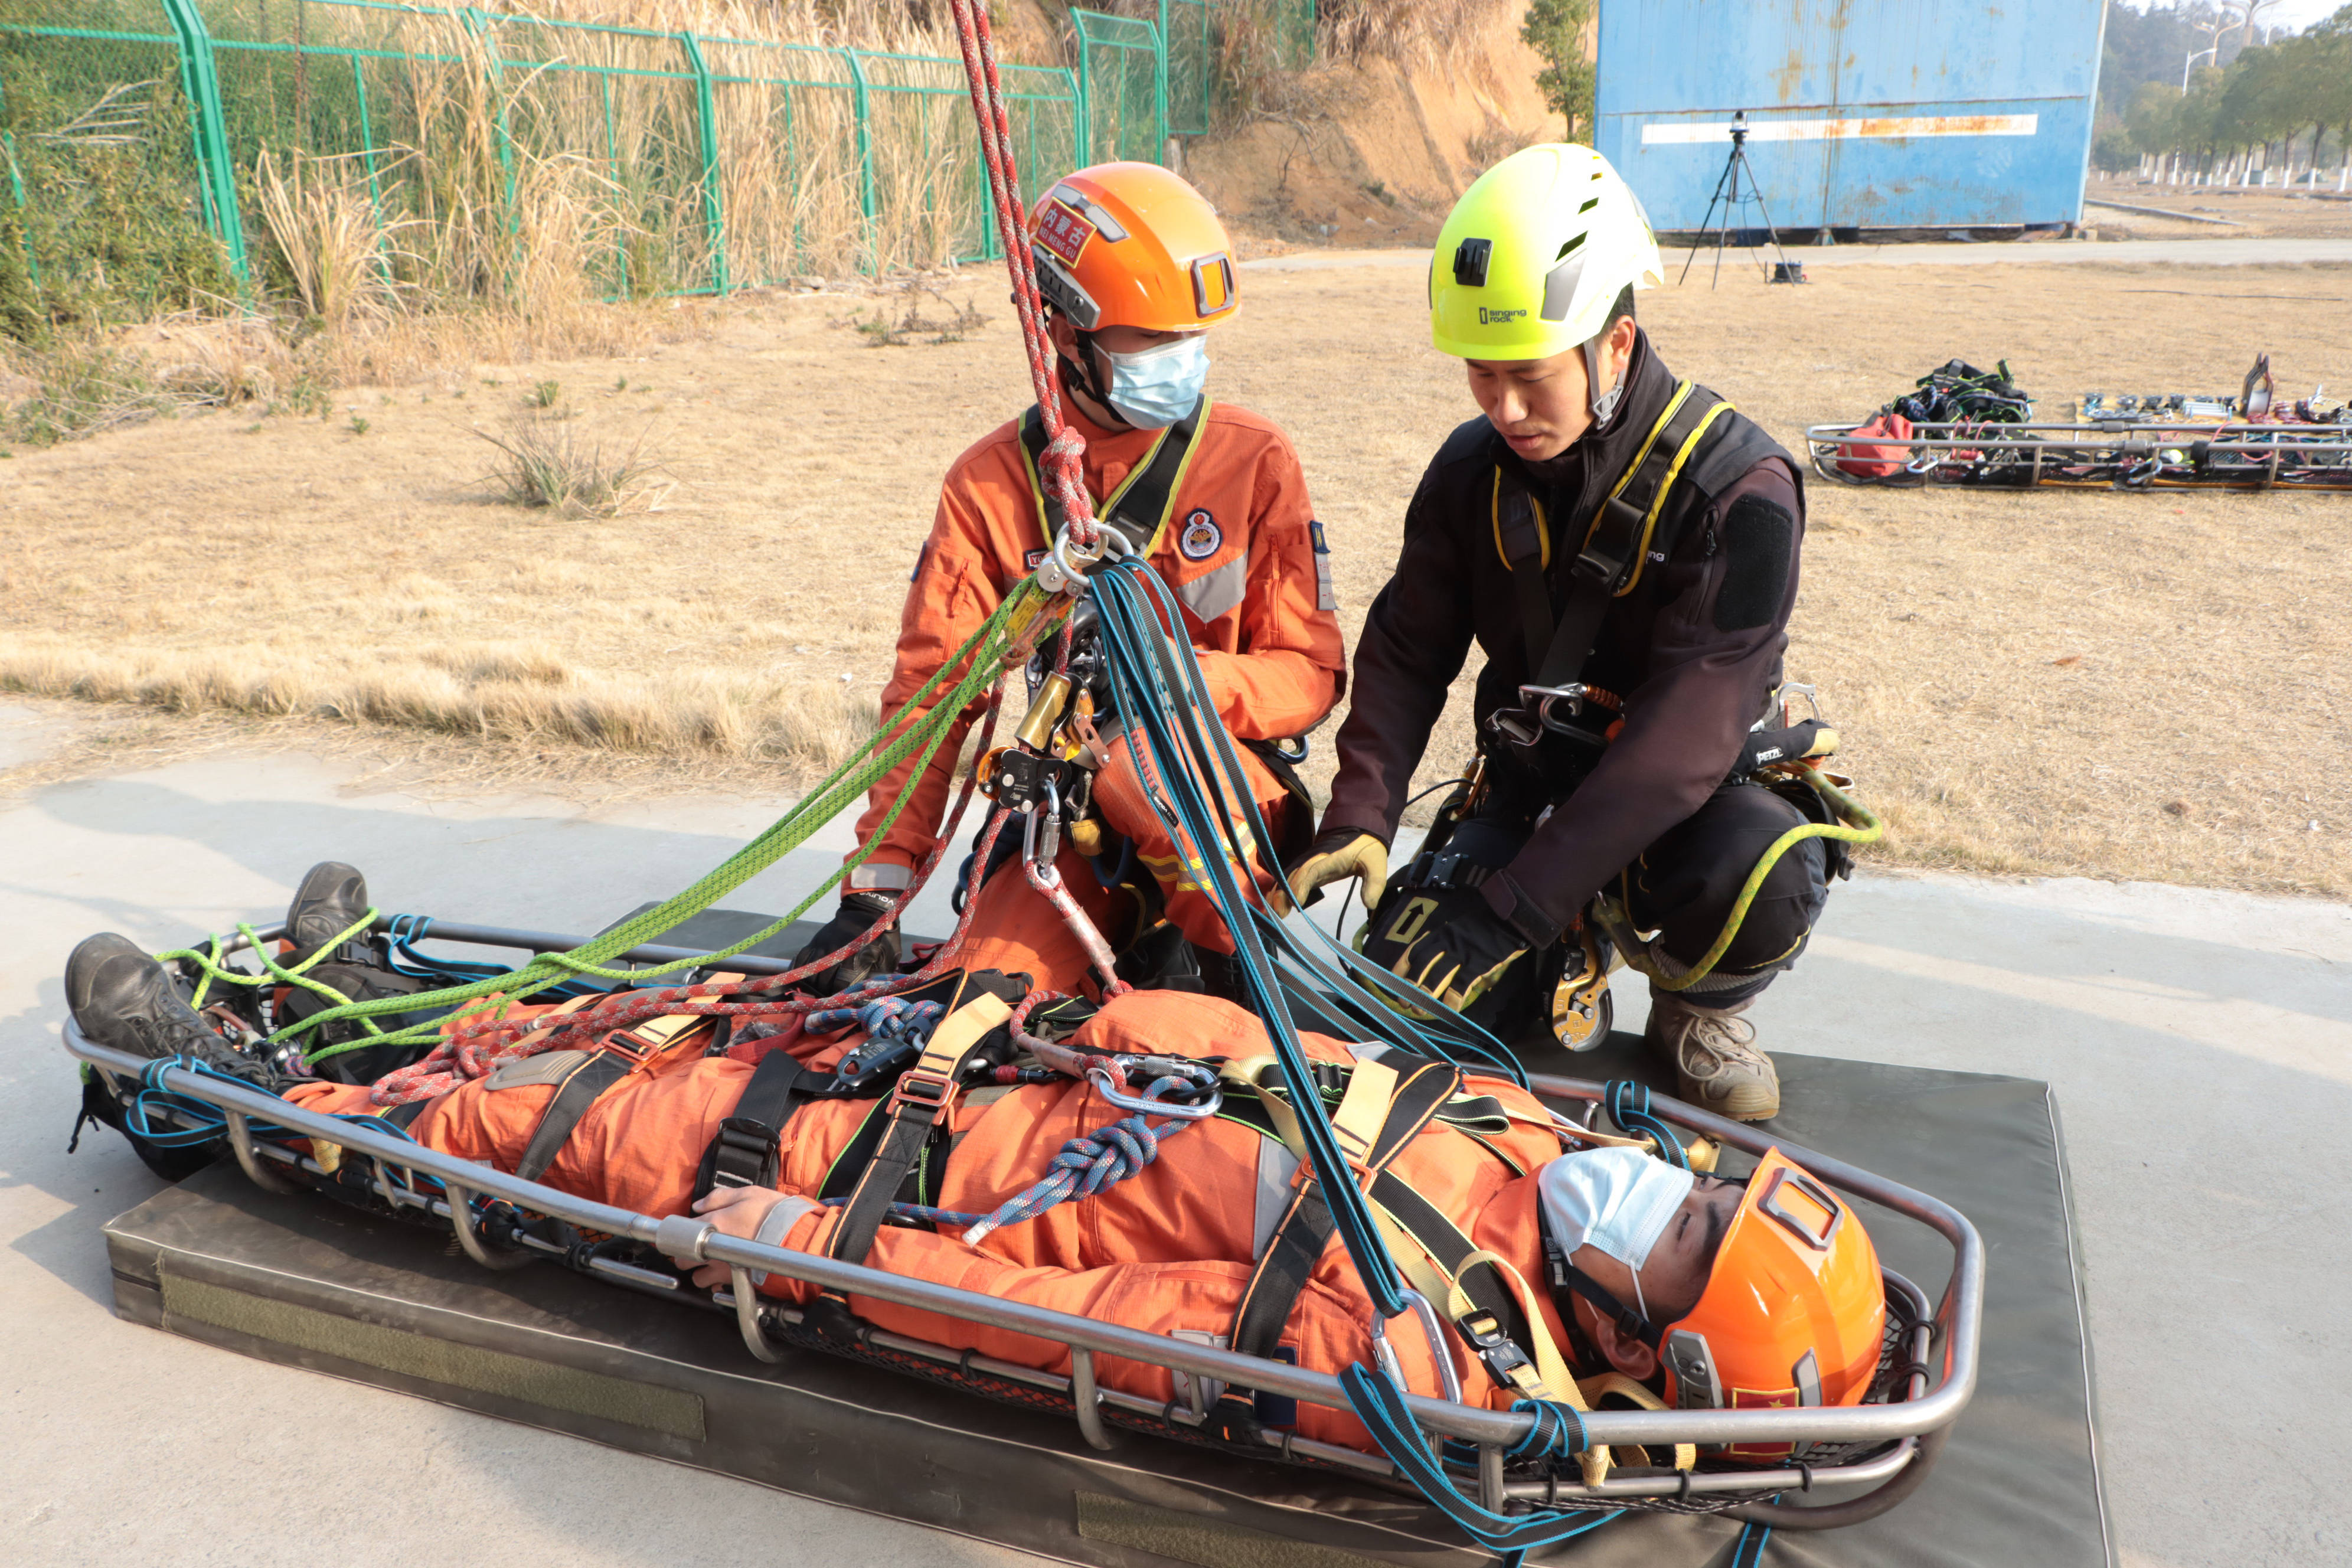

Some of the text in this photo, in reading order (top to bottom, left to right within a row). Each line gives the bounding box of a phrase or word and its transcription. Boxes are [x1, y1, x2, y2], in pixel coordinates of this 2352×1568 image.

[1039, 226, 1076, 258] NEI MENG GU
[1043, 208, 1086, 247] 内蒙古
